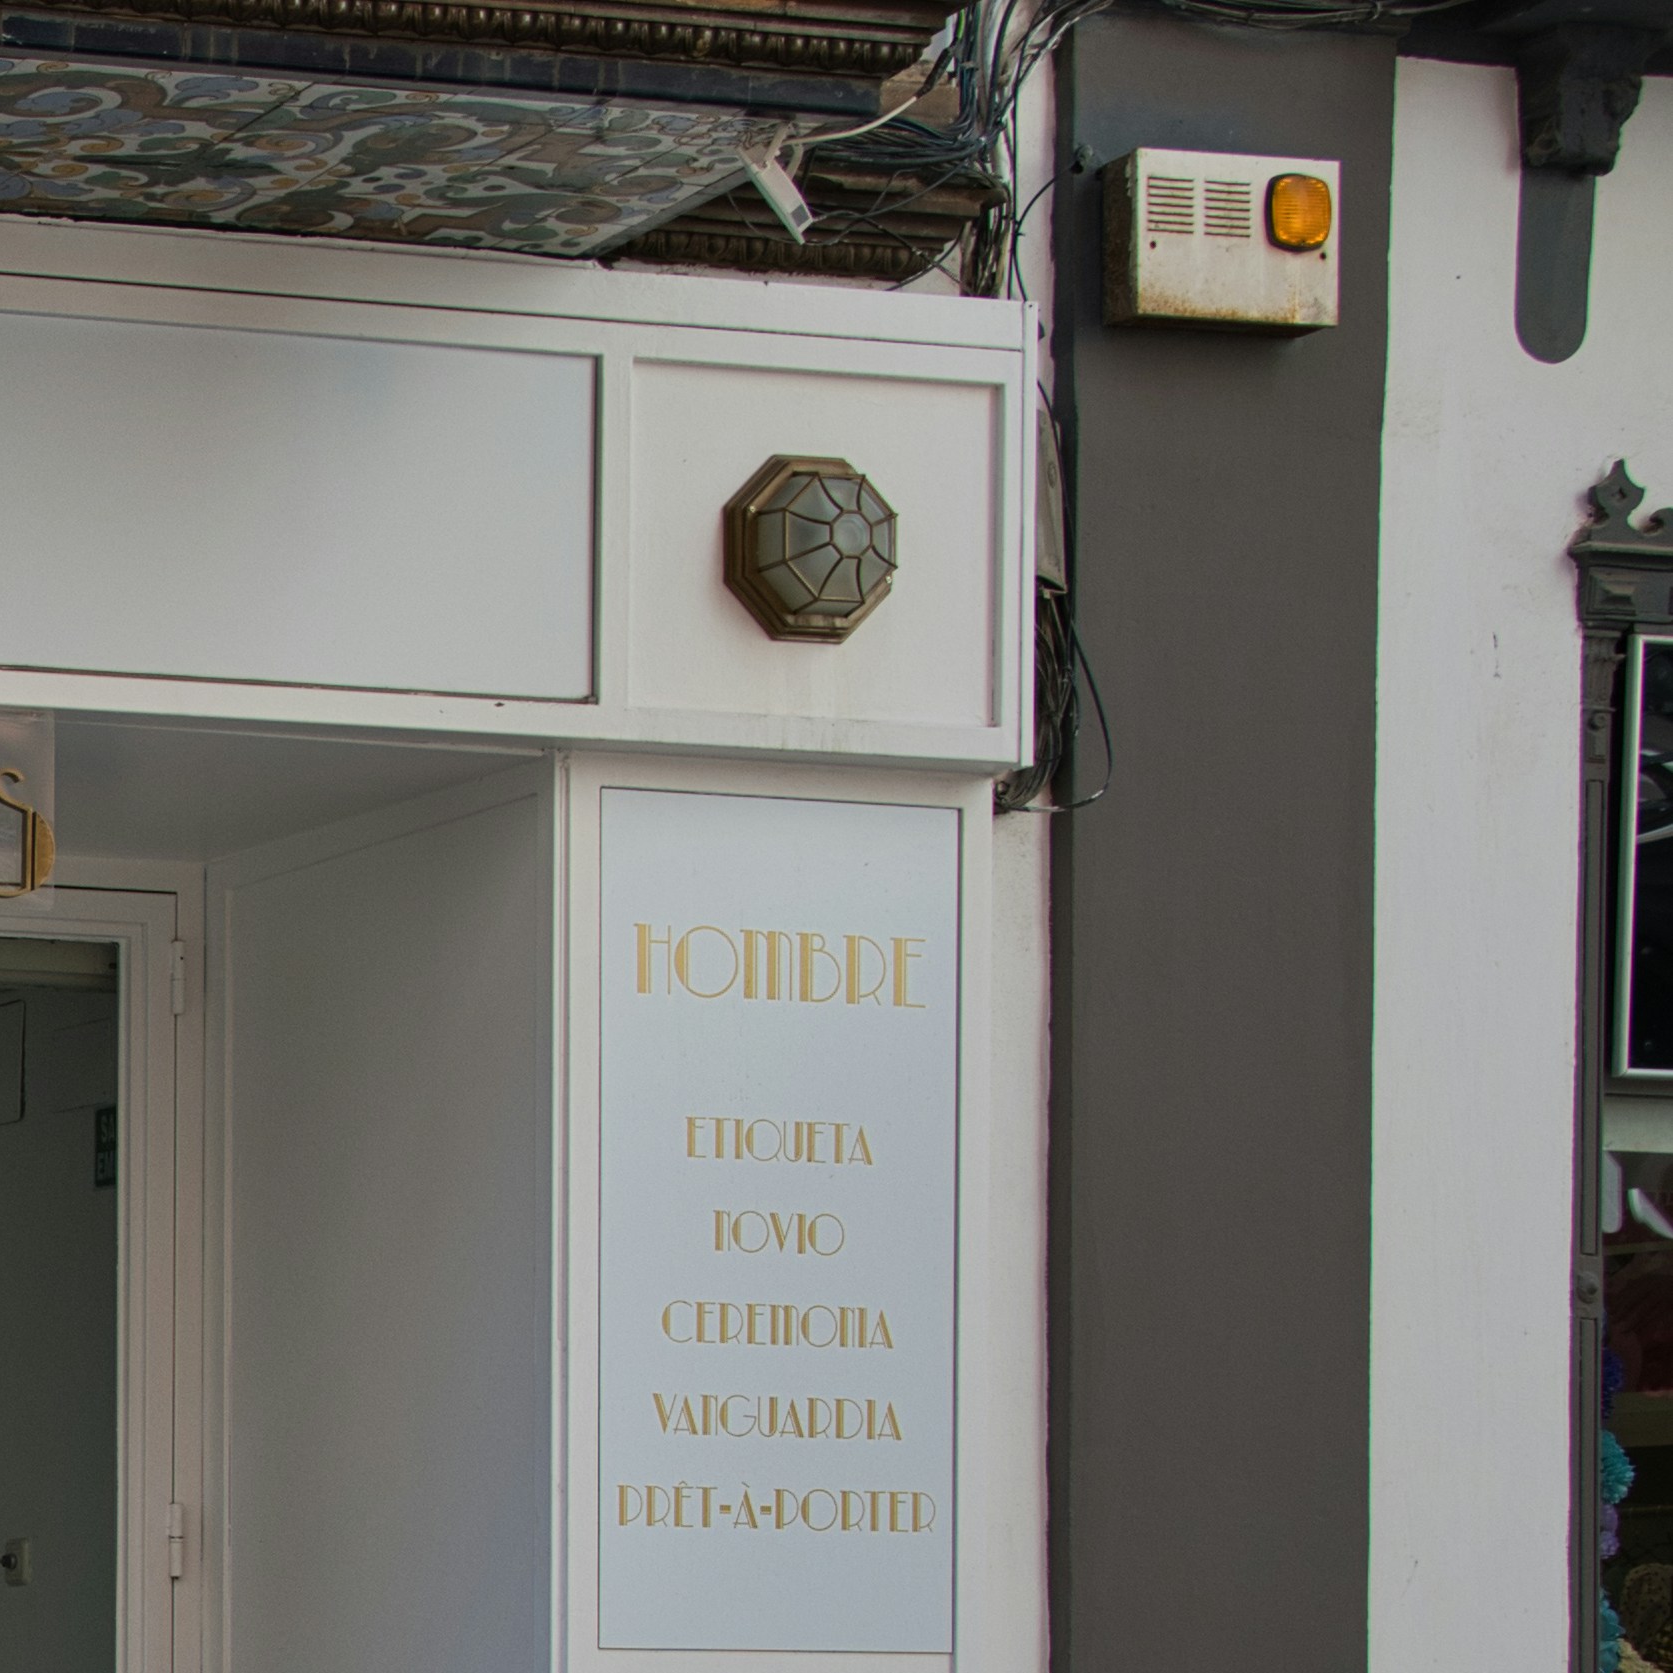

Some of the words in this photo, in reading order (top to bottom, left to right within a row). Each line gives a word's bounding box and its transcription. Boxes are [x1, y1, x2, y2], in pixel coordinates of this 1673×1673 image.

[633, 922, 927, 1009] HOMBRE
[685, 1115, 873, 1166] ETIQUETA
[713, 1209, 845, 1256] NOVIO
[660, 1300, 894, 1350] CEREMONIA
[652, 1392, 903, 1441] VANGUARDIA
[616, 1479, 937, 1534] PRÊT-À-PORTER
